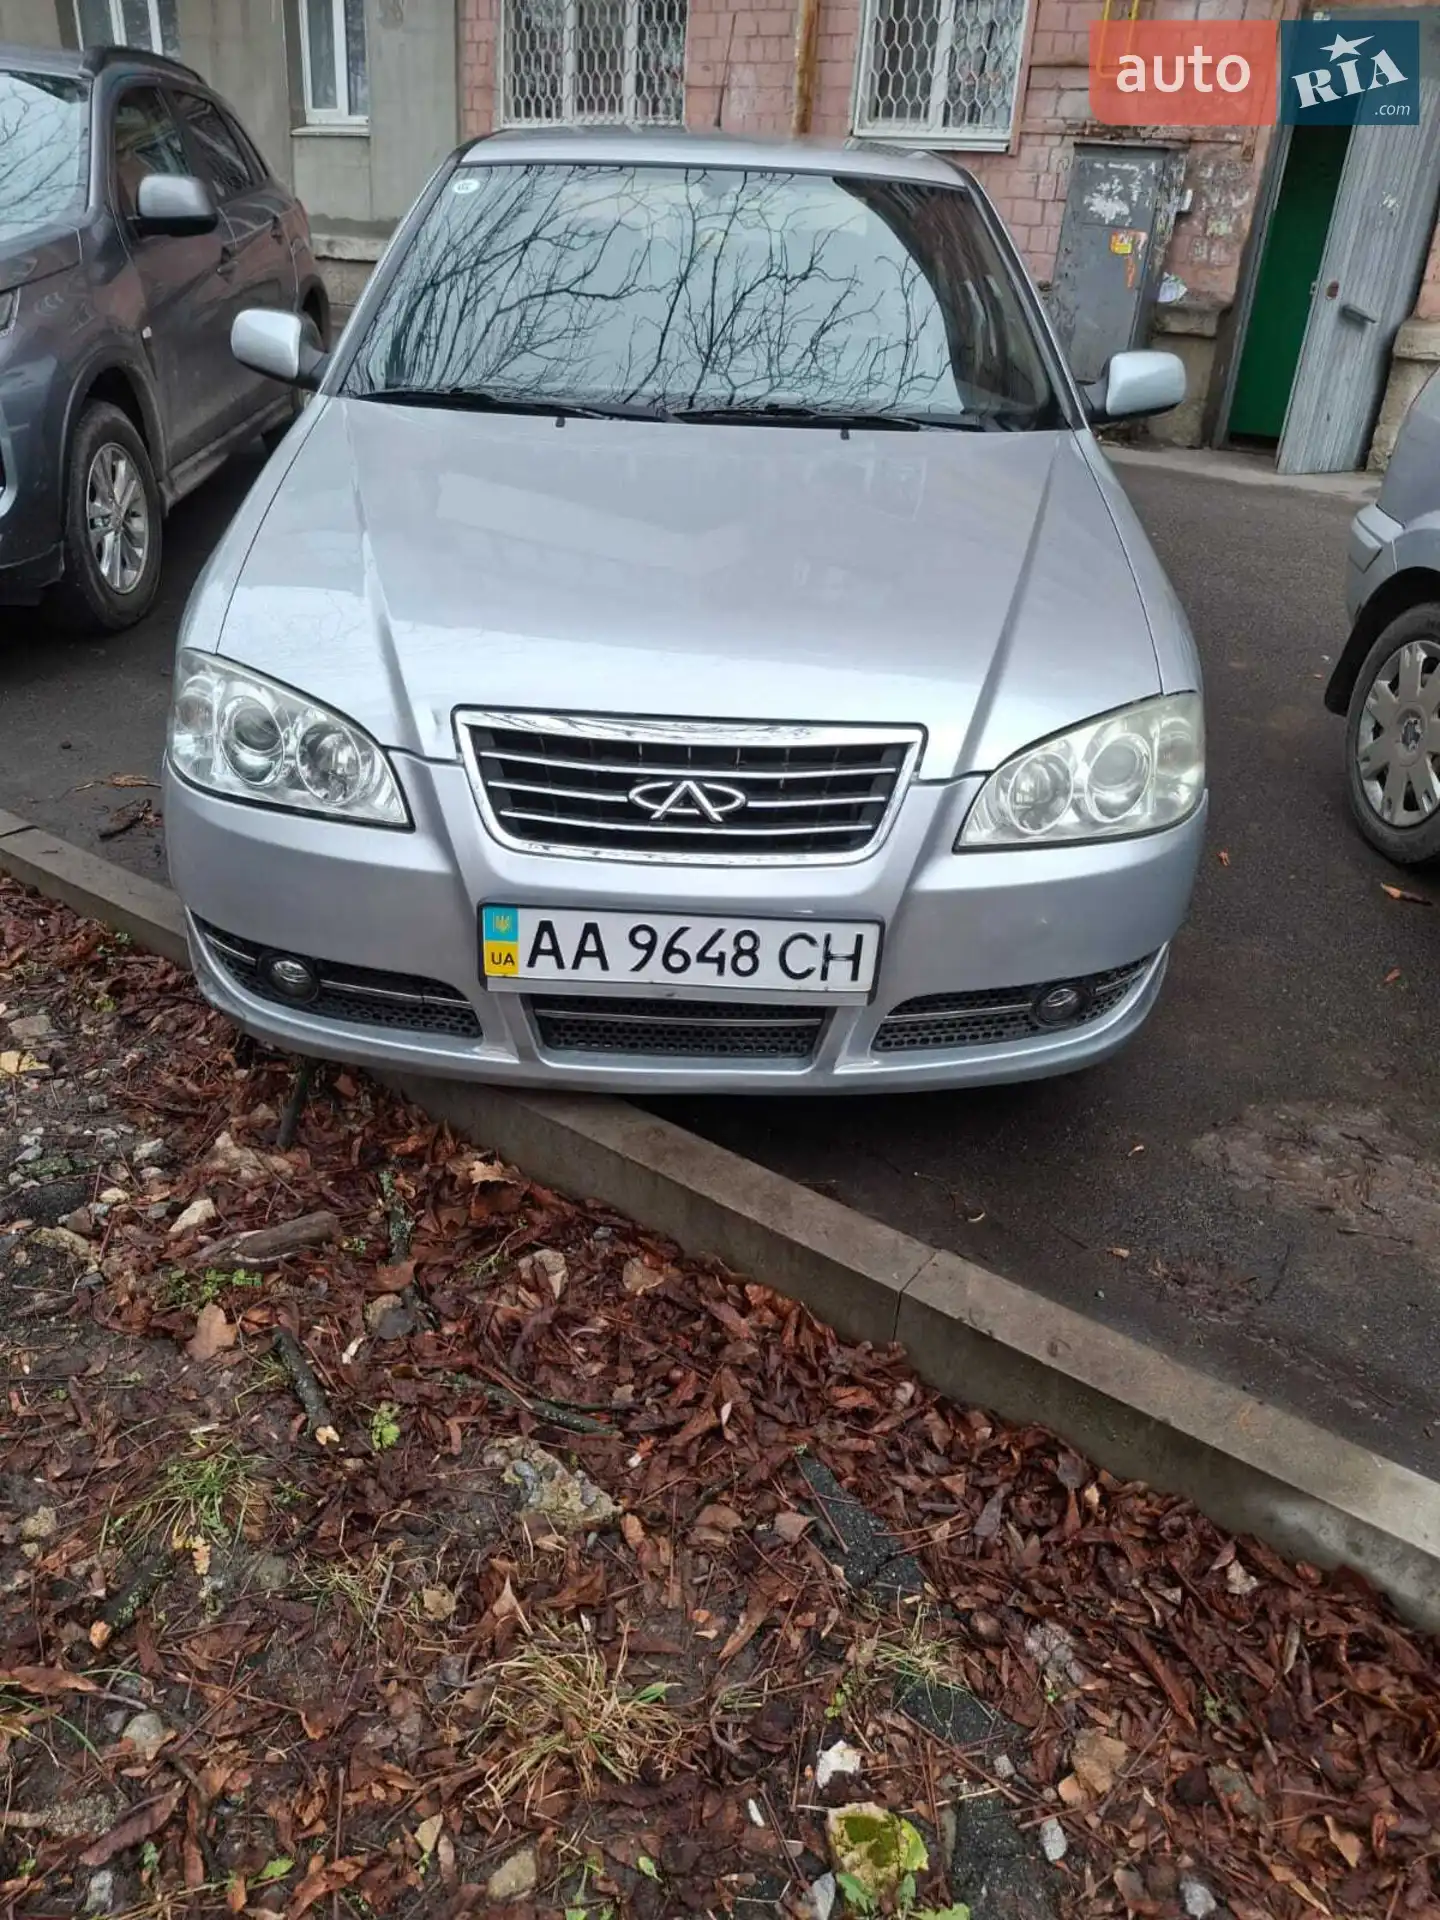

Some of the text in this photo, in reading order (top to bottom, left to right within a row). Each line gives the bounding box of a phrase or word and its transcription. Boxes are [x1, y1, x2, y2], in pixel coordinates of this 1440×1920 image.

[491, 951, 515, 966] UA
[526, 919, 864, 982] AA 9648 CH
